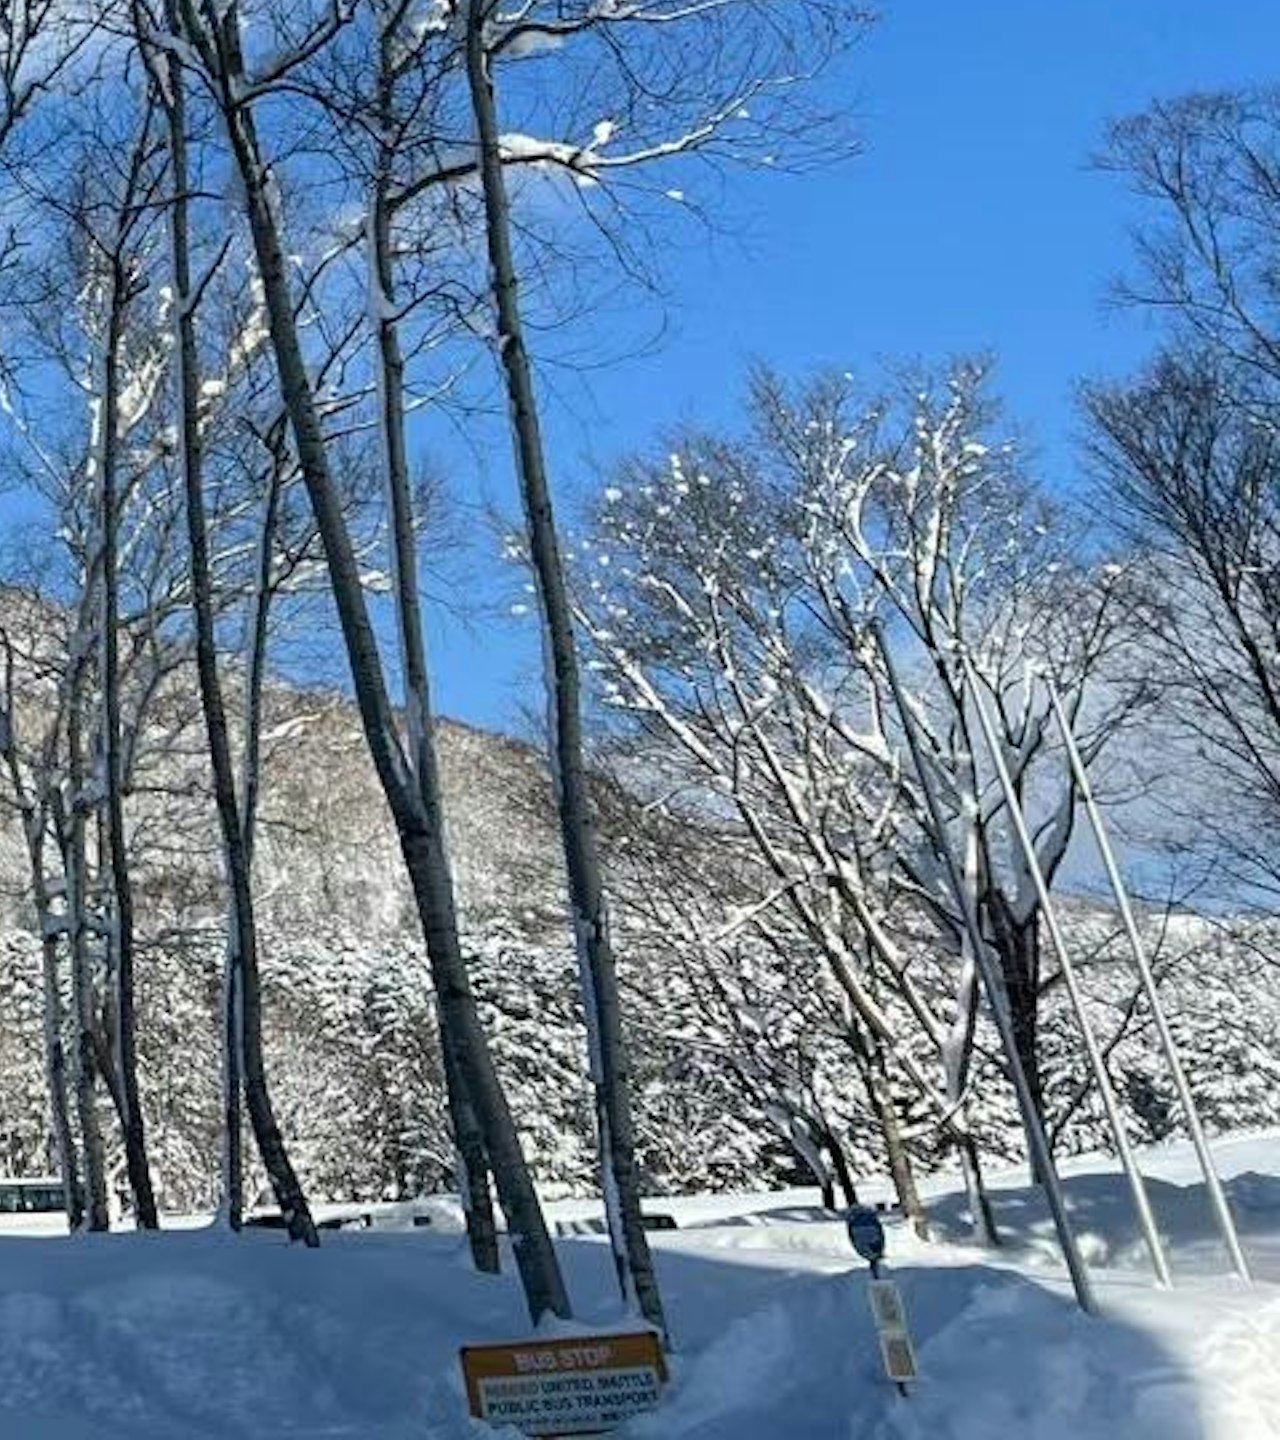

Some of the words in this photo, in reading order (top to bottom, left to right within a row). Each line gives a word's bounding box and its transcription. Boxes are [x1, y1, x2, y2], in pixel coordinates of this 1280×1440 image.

[514, 1353, 556, 1371] BUS
[559, 1347, 613, 1367] STOP
[489, 1397, 539, 1414] PUBLIC
[541, 1396, 571, 1411] BUS
[574, 1389, 658, 1409] TRANSPORT
